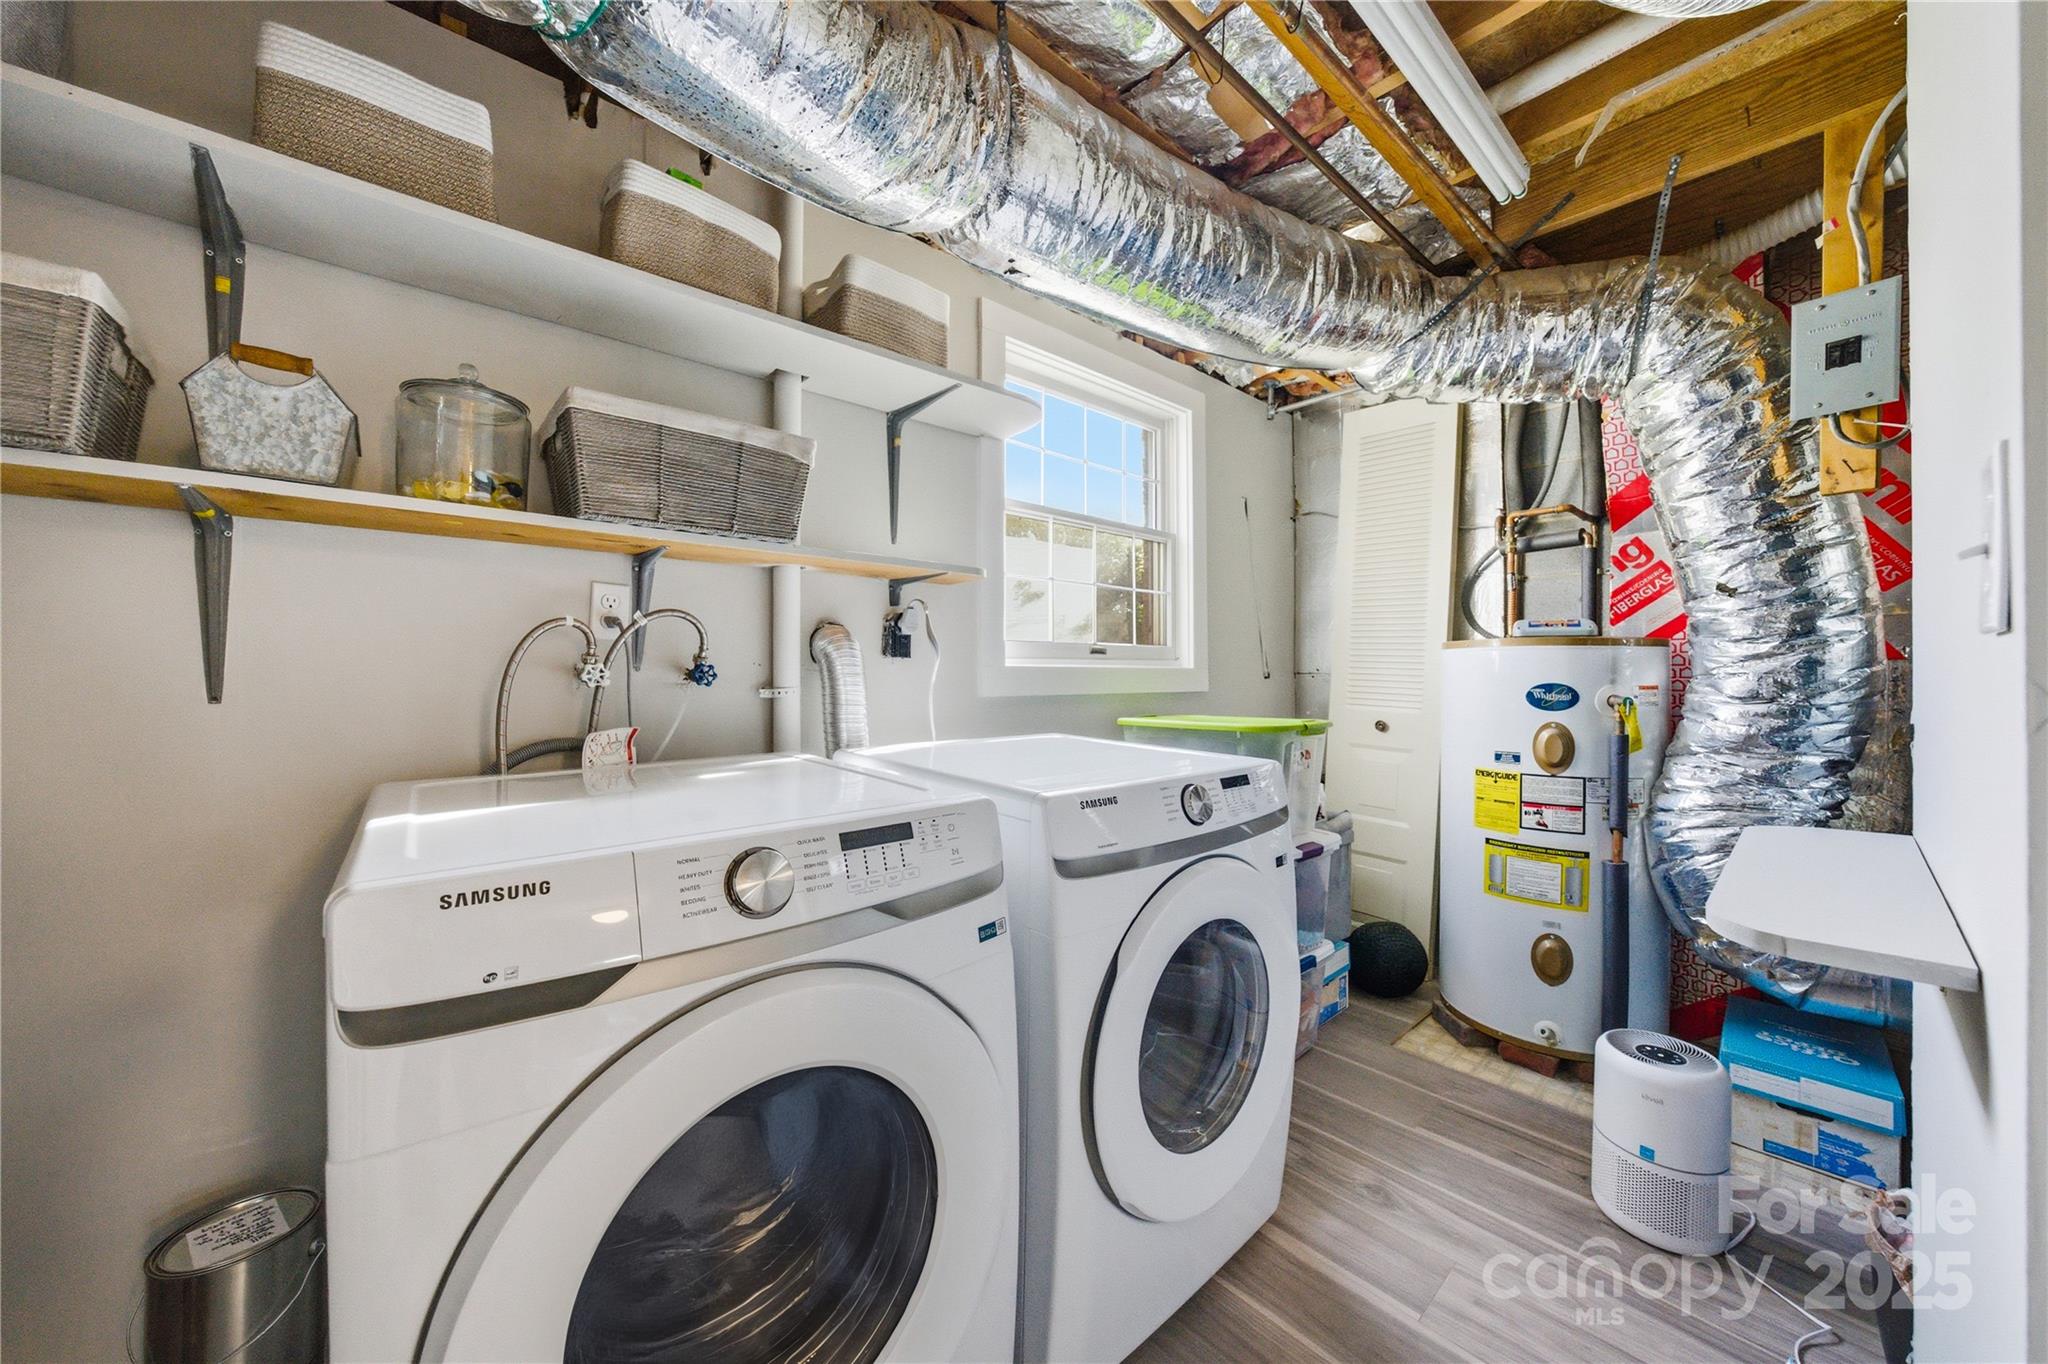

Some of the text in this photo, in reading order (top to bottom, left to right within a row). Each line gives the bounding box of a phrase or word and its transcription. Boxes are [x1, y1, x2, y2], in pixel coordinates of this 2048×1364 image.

[1079, 796, 1118, 810] SAMSUNG
[676, 857, 701, 866] NORMAL
[678, 870, 713, 881] HEAVY DUTY
[439, 880, 551, 910] SAMSUNG
